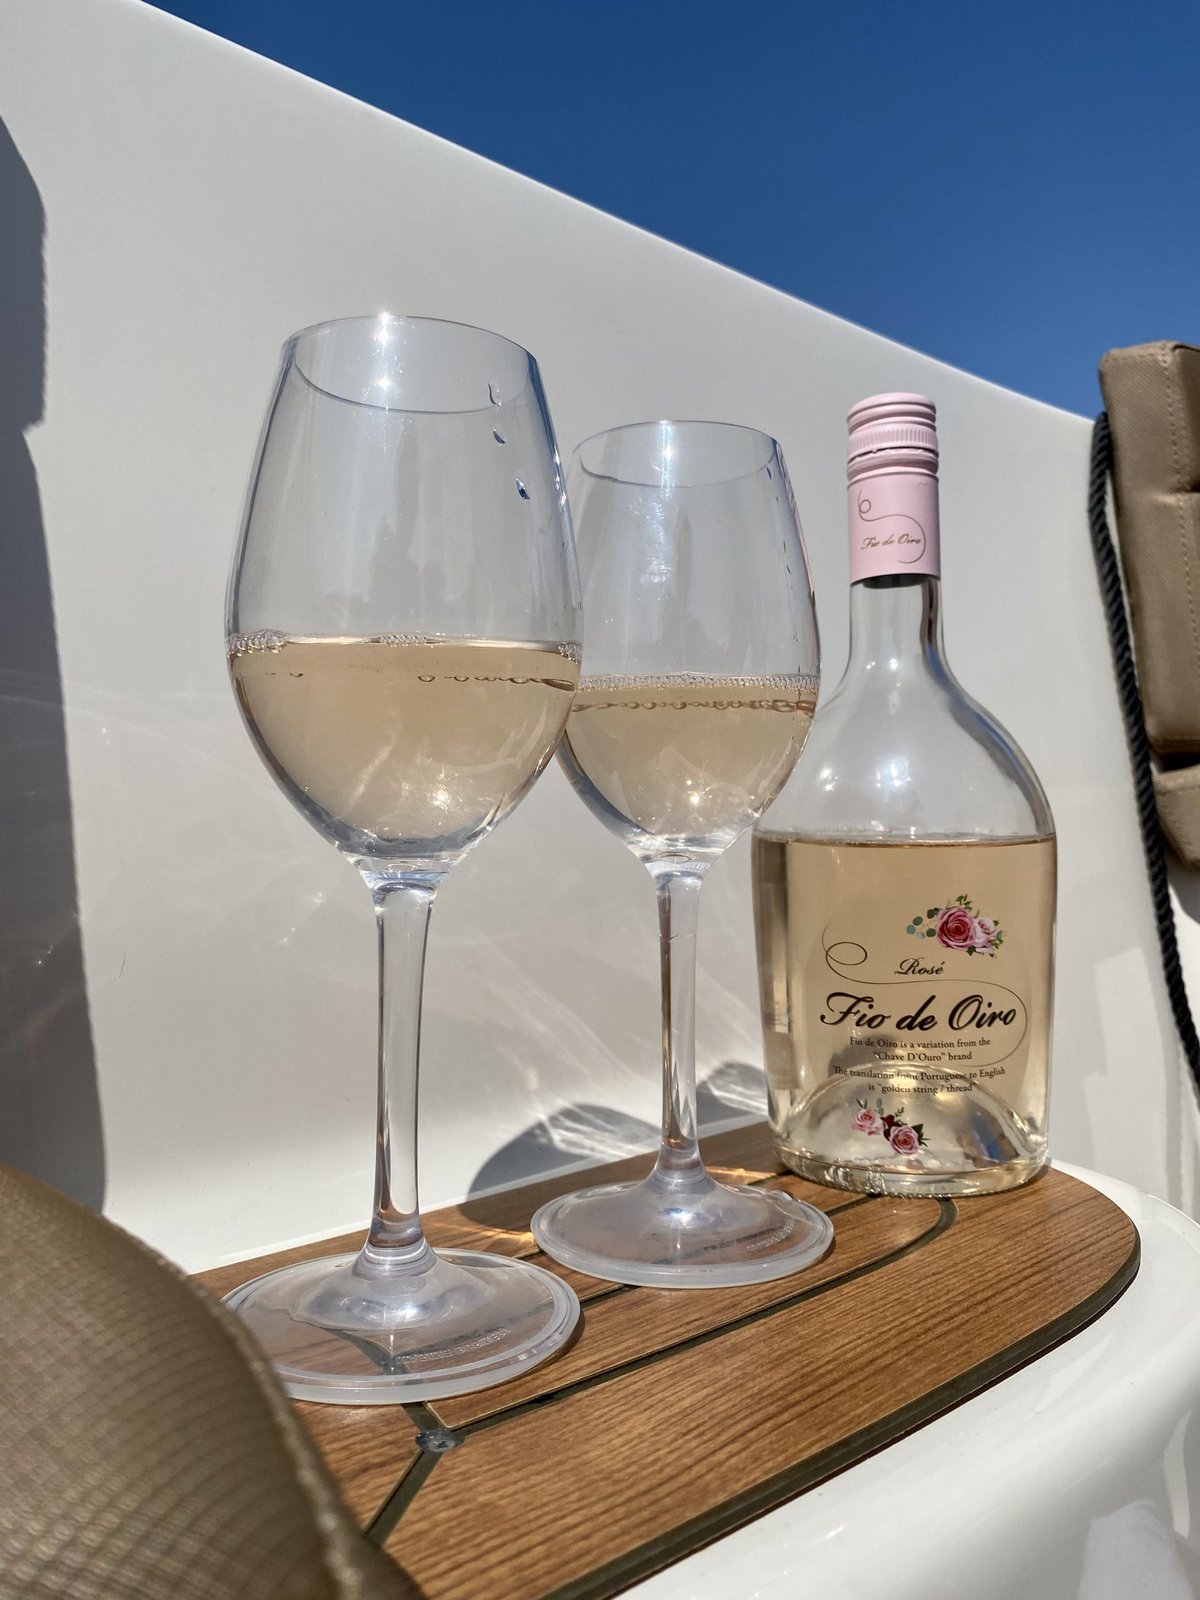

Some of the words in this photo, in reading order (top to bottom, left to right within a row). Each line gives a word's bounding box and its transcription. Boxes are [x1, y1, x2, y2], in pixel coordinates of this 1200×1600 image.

[861, 537, 880, 551] Fio
[882, 533, 895, 546] de
[897, 533, 921, 545] Oiro
[894, 957, 946, 976] Rosé
[820, 991, 891, 1029] Fio
[895, 994, 937, 1032] de
[948, 994, 1016, 1030] Oiro
[850, 1036, 863, 1046] Fio
[865, 1037, 876, 1047] de
[877, 1038, 898, 1048] Oiro
[900, 1039, 908, 1048] is
[917, 1039, 955, 1049] variation
[957, 1038, 977, 1048] from
[979, 1037, 991, 1046] the
[948, 1051, 973, 1061] brand
[833, 1065, 848, 1075] The
[850, 1069, 894, 1079] translation
[896, 1070, 918, 1081] from
[921, 1072, 967, 1083] Portuguese
[969, 1069, 977, 1078] to
[979, 1066, 1006, 1080] English
[868, 1083, 875, 1091] is
[913, 1084, 938, 1095] string
